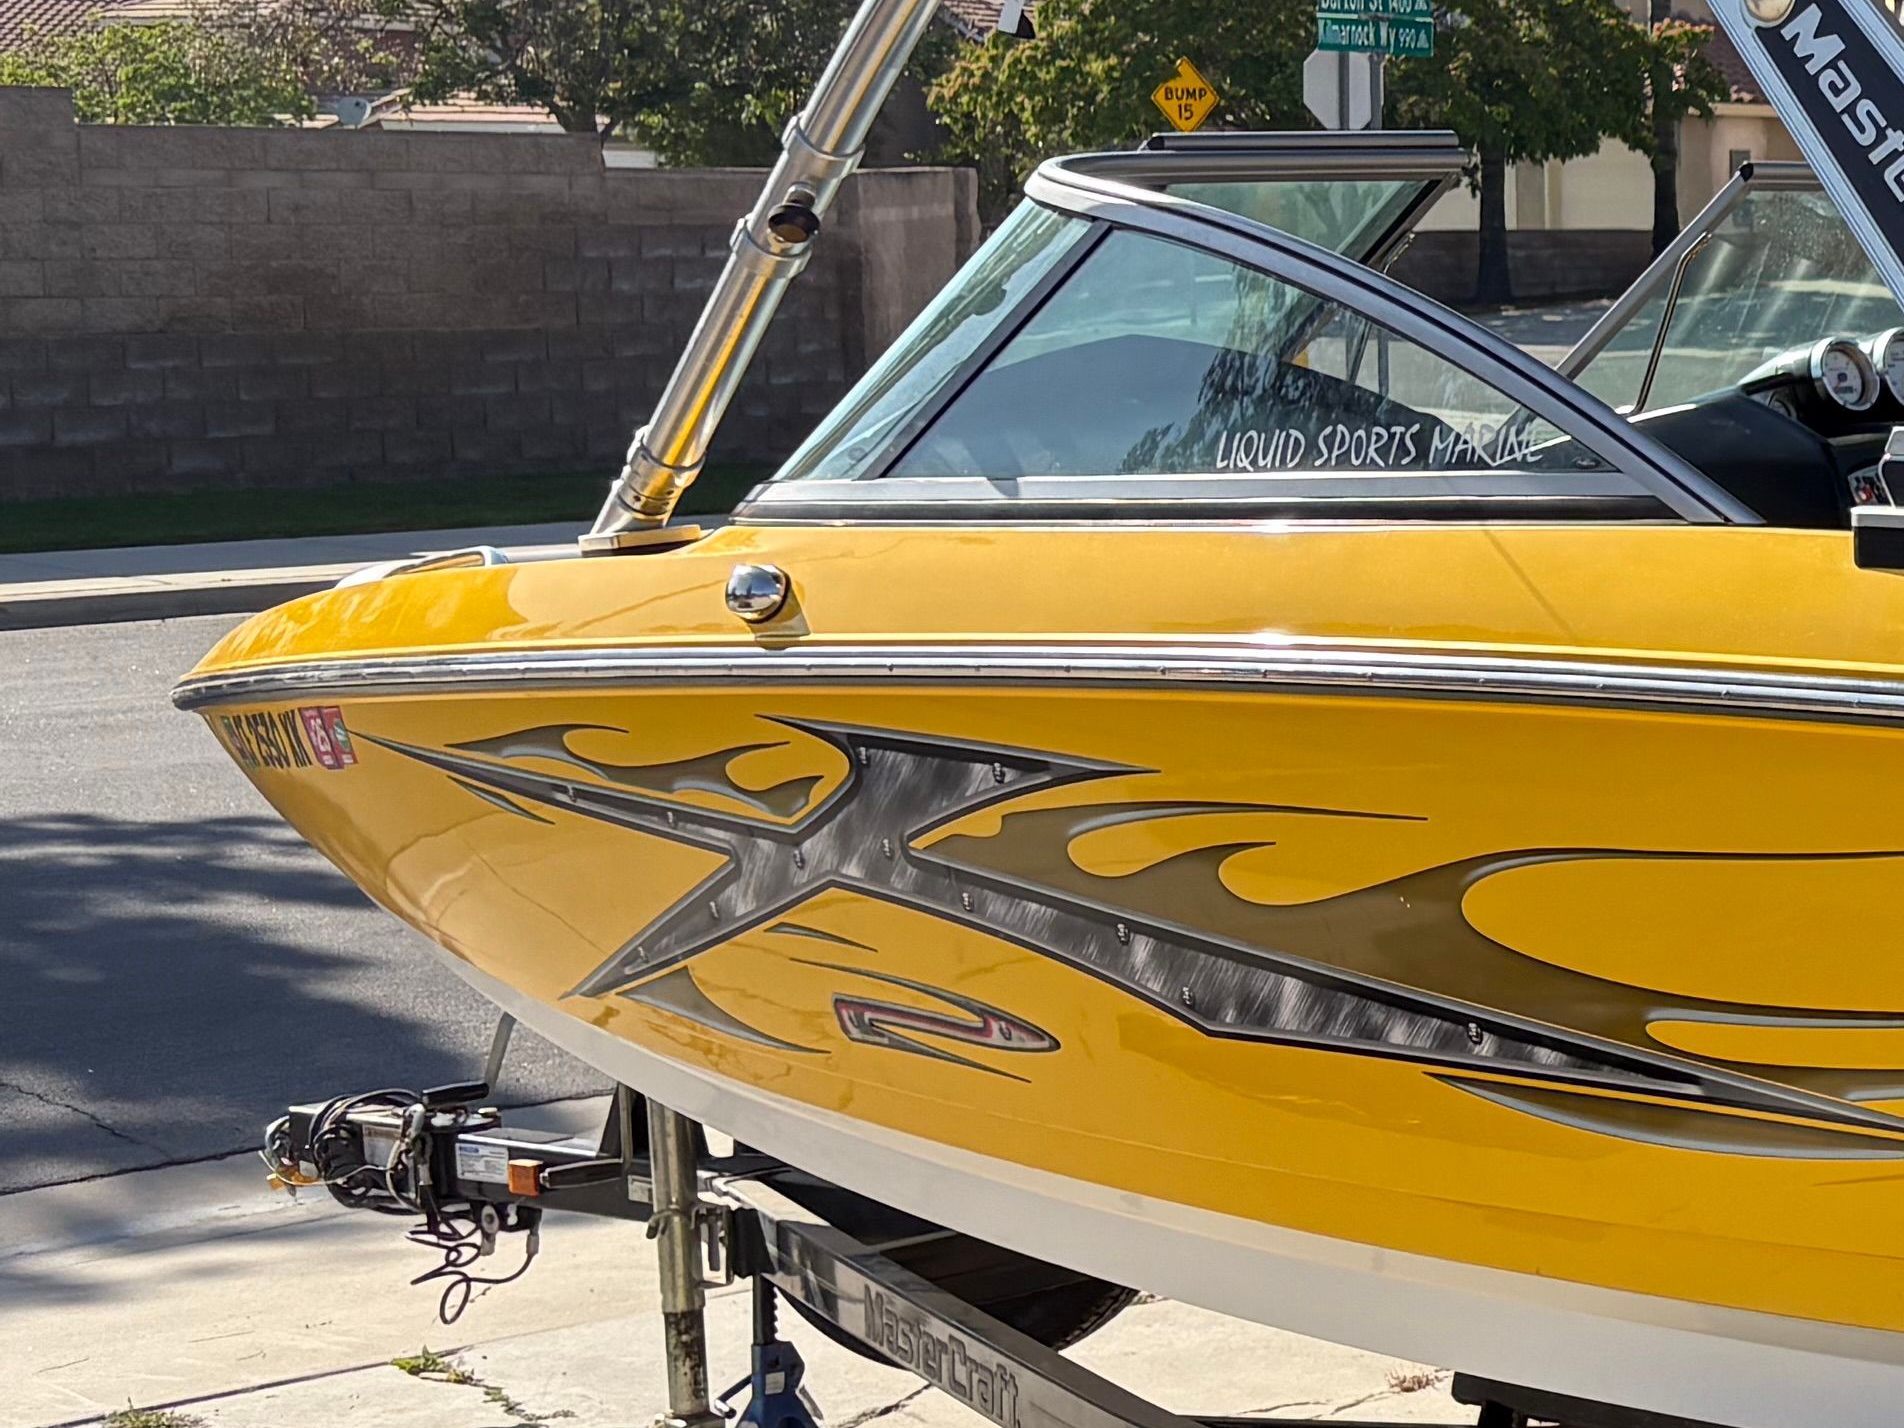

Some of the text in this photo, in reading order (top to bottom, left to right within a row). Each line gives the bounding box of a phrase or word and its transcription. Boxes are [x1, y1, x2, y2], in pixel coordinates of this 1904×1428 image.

[1163, 86, 1207, 102] BUMP
[1177, 104, 1195, 121] 15
[1213, 416, 1546, 471] LIQUID SPORTS MARINE
[863, 1283, 1021, 1427] MasterCraft
